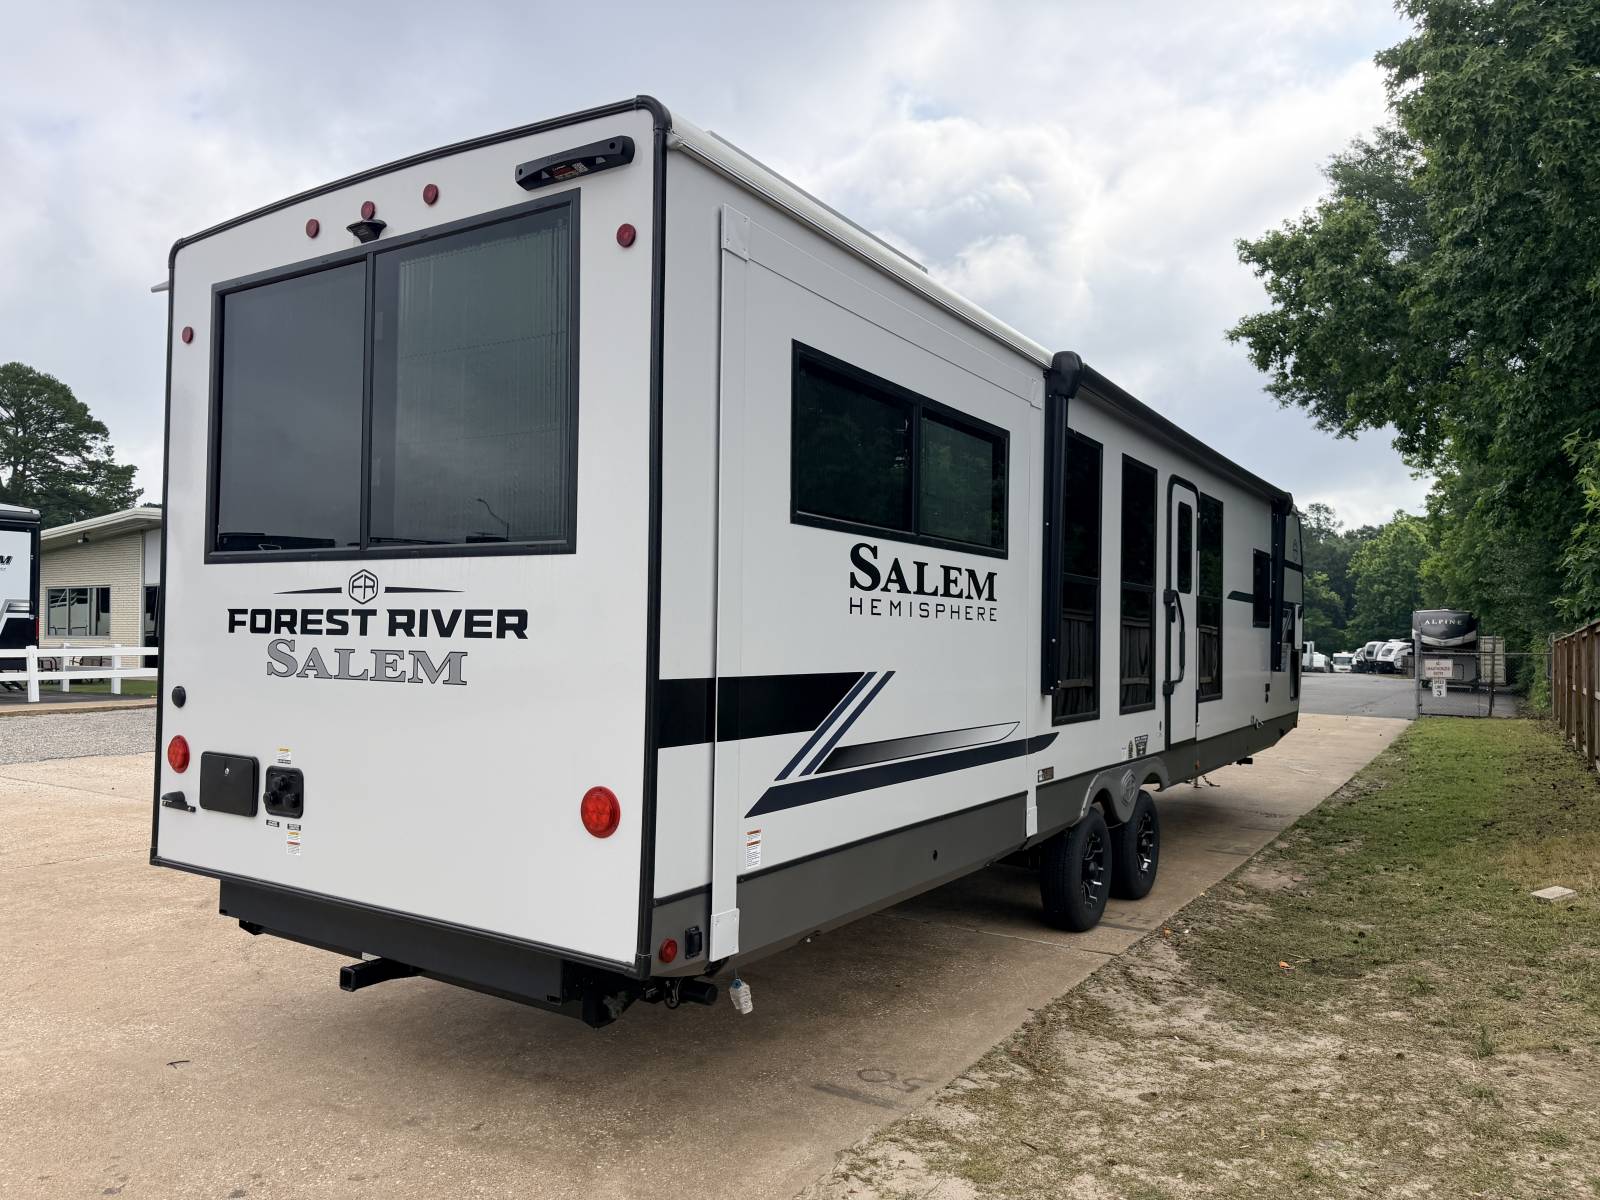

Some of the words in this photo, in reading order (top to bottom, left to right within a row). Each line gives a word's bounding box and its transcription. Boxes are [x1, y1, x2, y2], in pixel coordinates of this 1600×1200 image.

[849, 542, 998, 602] SALEM
[227, 608, 378, 637] FOREST
[386, 609, 529, 640] RIVER
[849, 597, 998, 622] HEMISPHERE
[266, 638, 468, 686] SALEM
